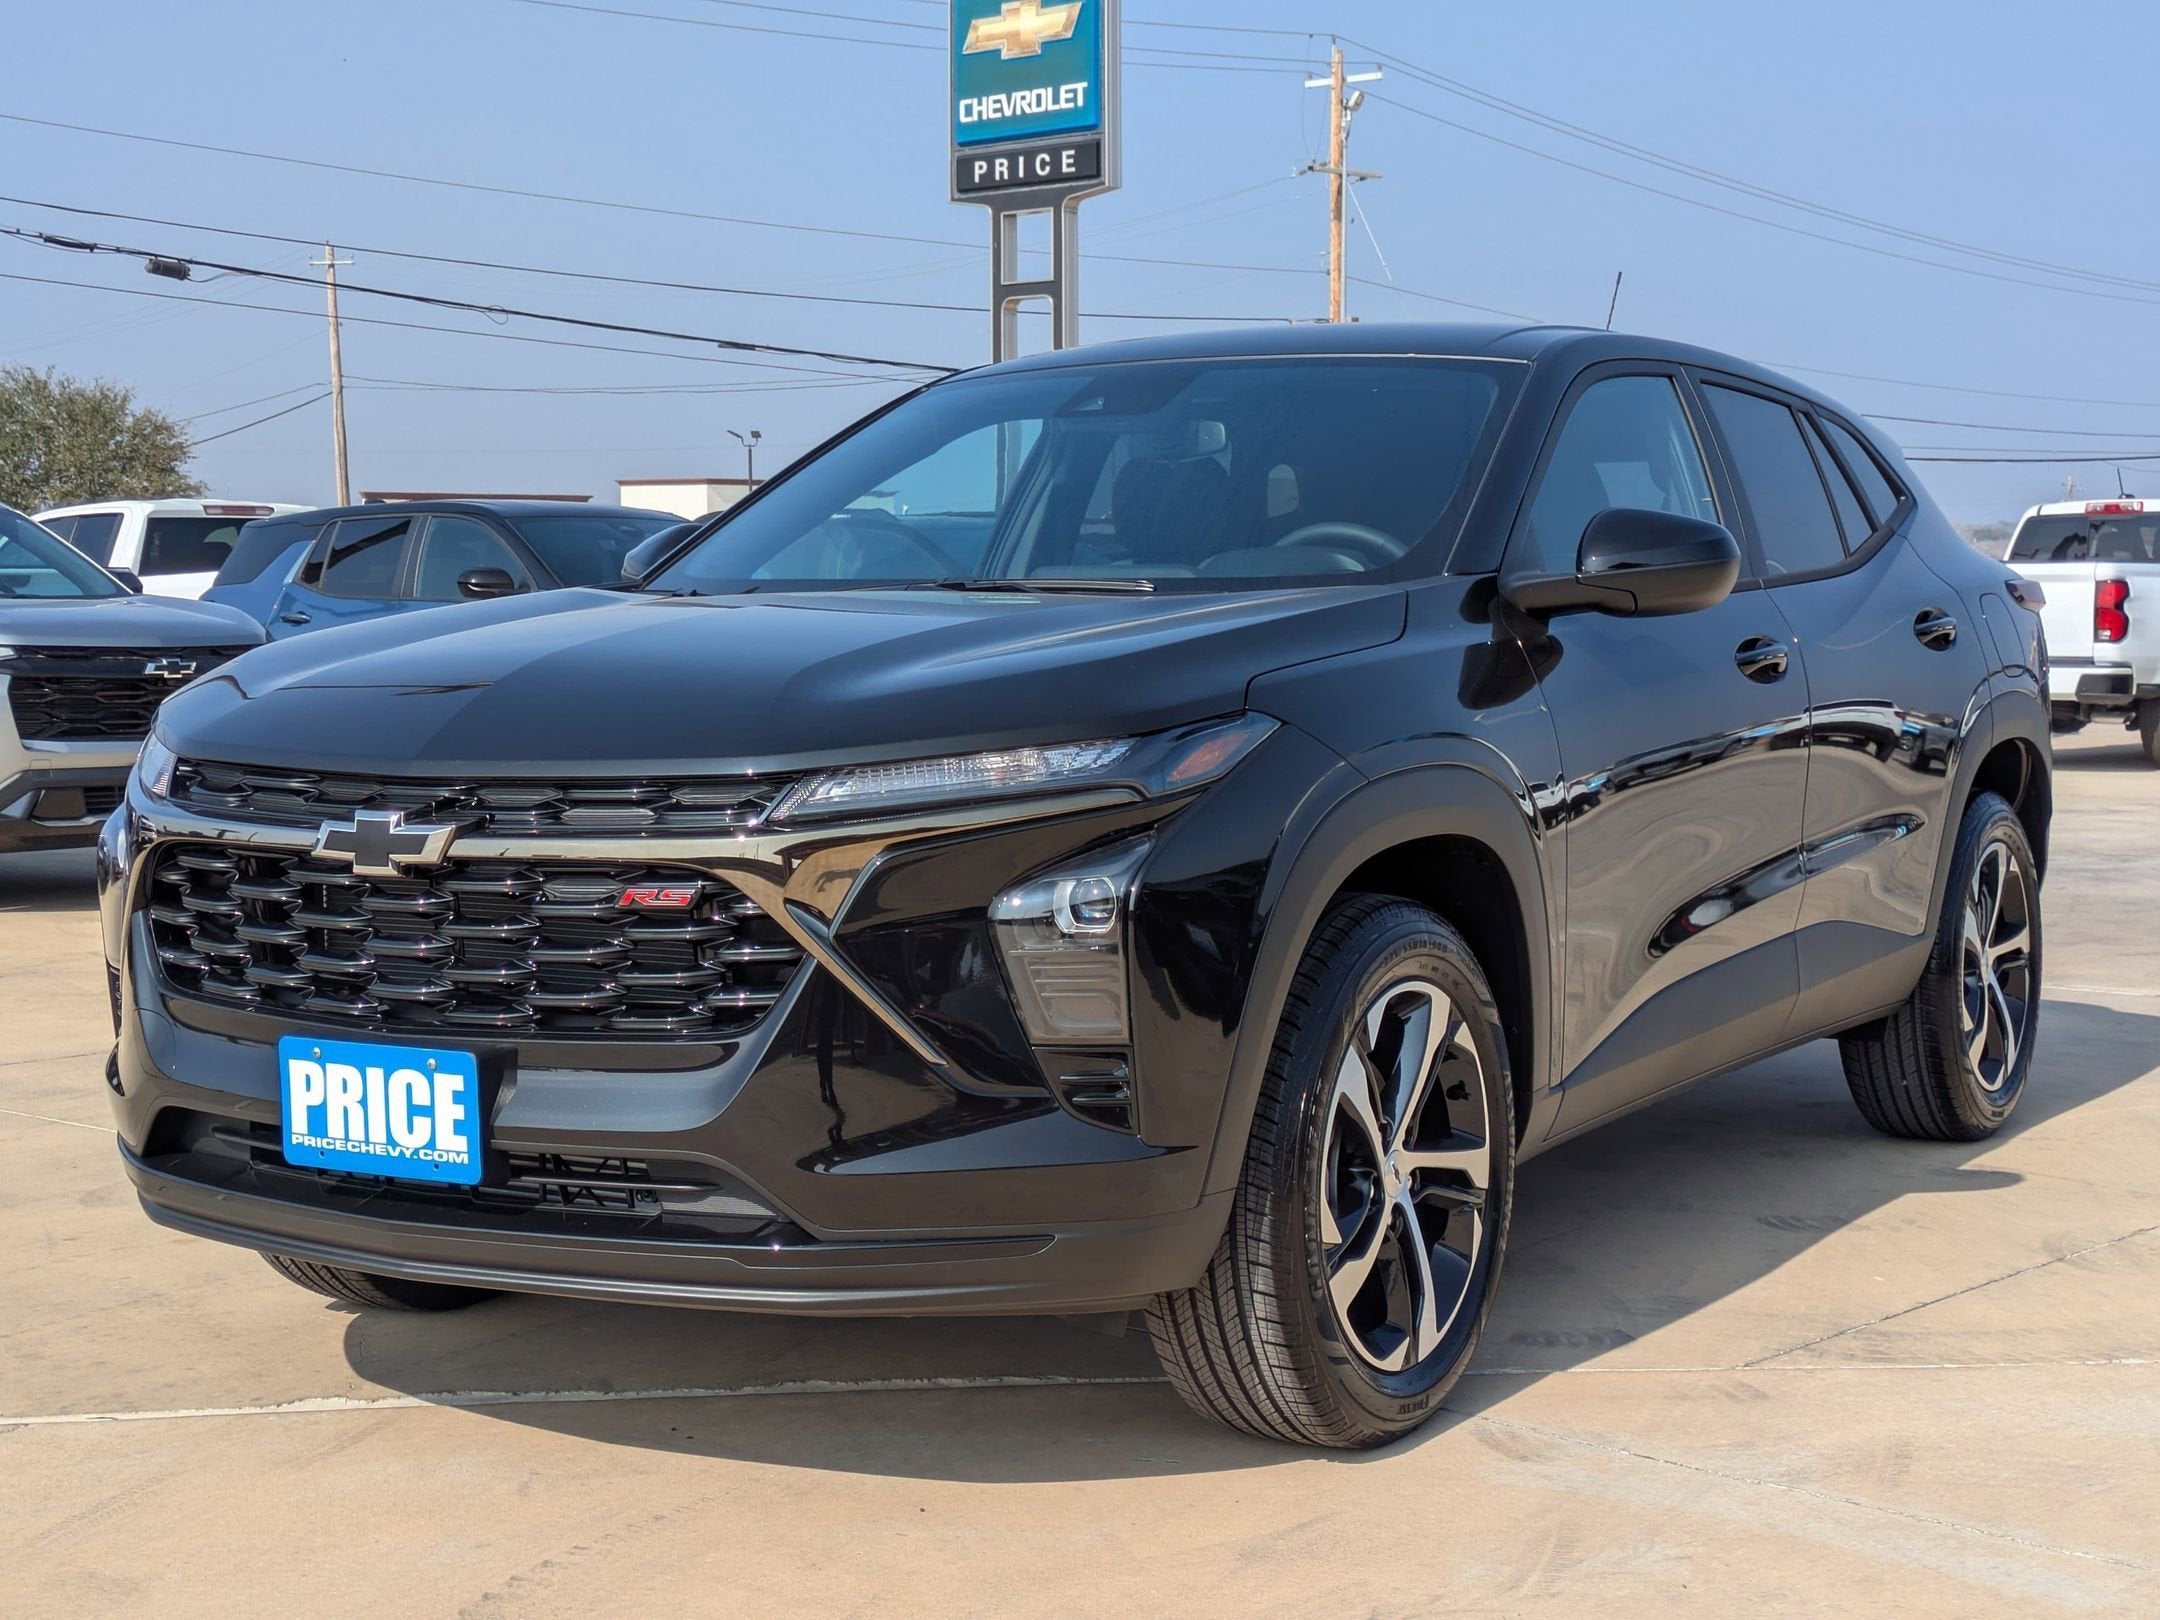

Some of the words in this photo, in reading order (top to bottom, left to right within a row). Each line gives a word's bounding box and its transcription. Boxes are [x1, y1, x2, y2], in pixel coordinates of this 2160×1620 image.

[959, 81, 1088, 123] CHEVROLET
[974, 149, 1076, 183] PRICE
[618, 888, 696, 907] RS
[288, 1058, 468, 1153] PRICE
[291, 1133, 469, 1165] PRICECHEVY.COM
